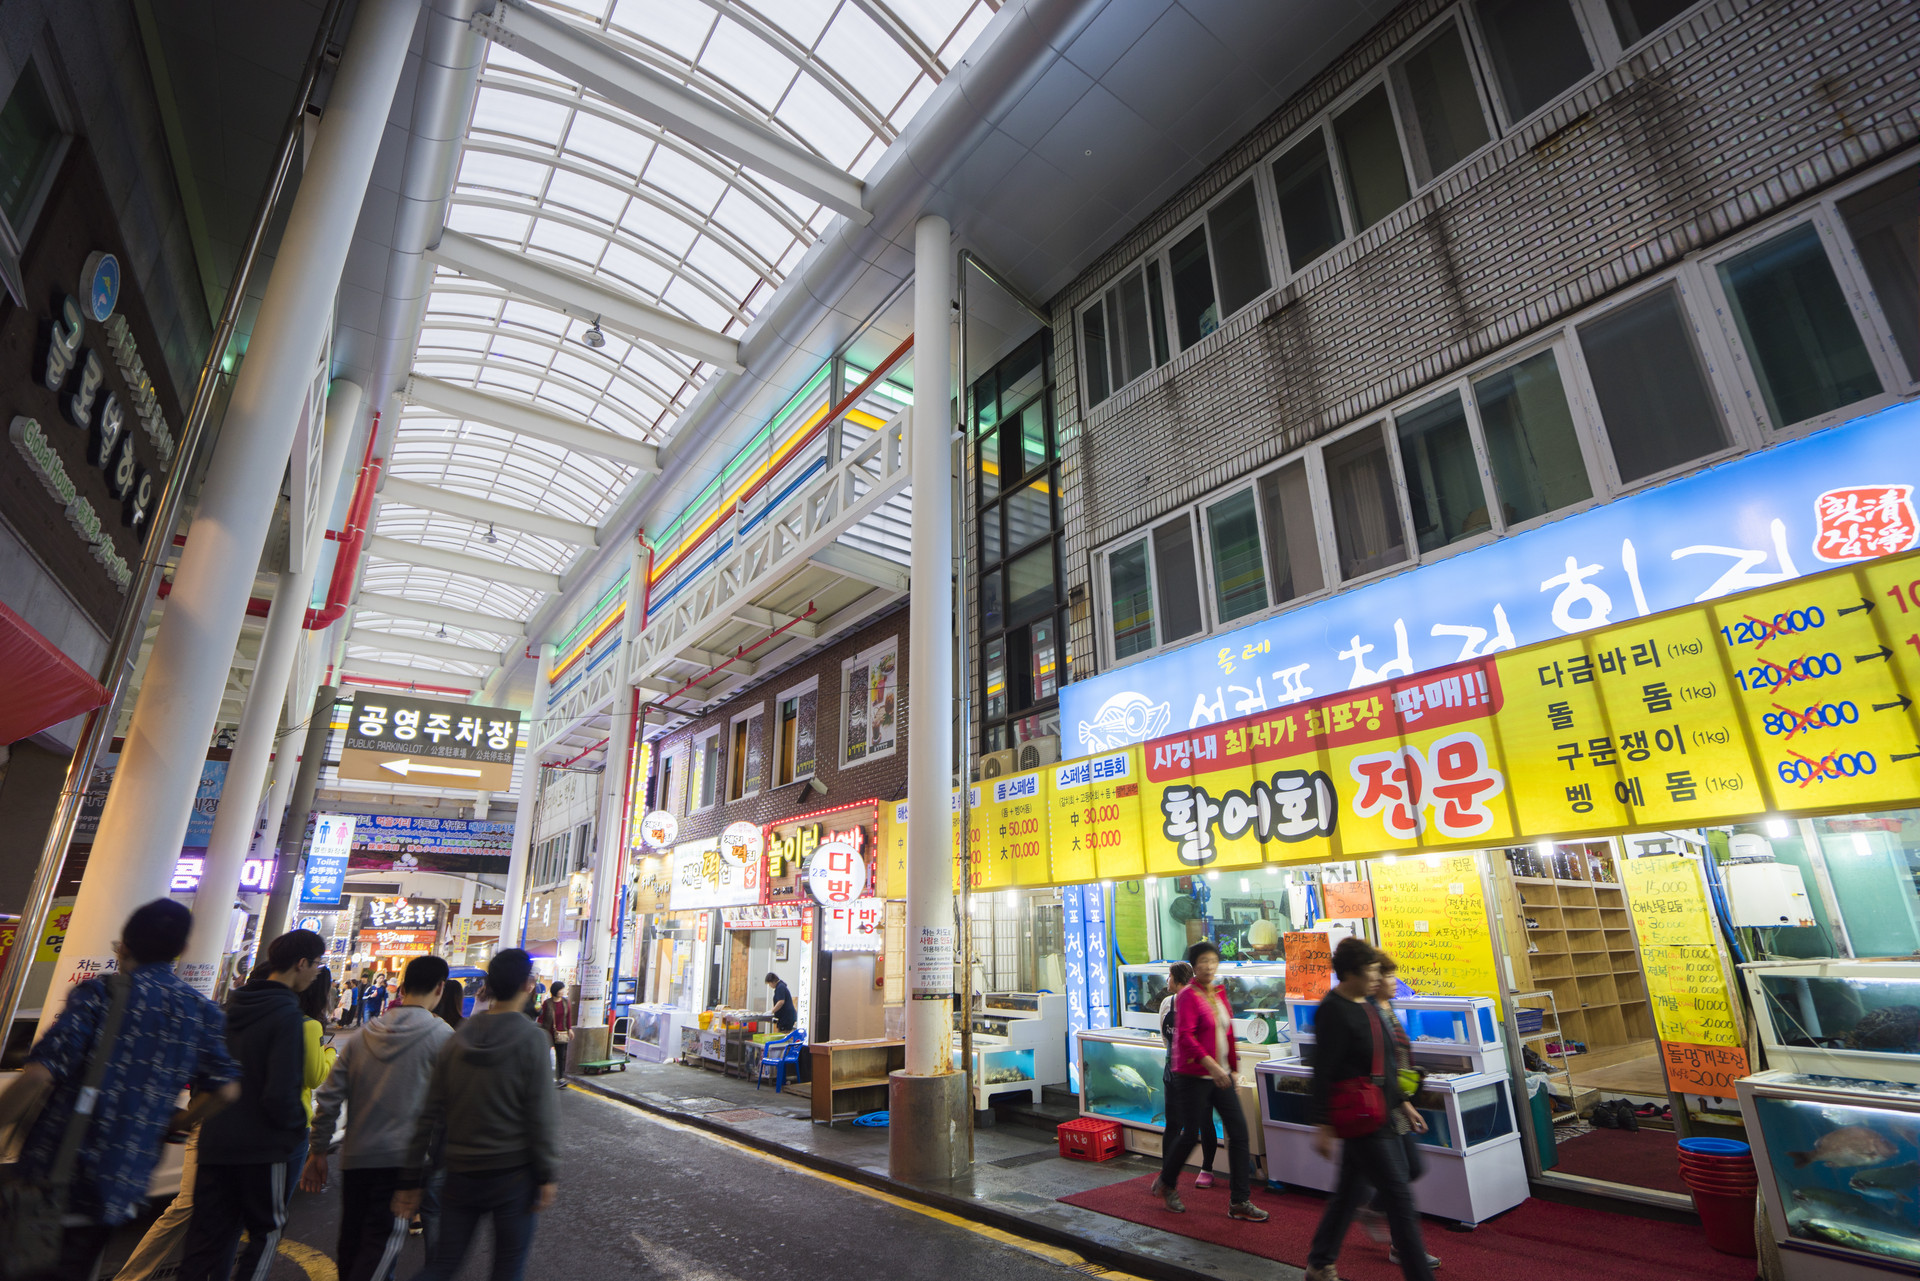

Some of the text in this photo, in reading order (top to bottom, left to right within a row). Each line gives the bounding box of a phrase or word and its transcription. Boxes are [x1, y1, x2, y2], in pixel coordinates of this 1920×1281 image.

[23, 419, 77, 505] Global House
[1720, 605, 1826, 647] 120,000
[1217, 640, 1271, 675] 올레
[1538, 638, 1703, 688] 다금바리 (1kg)
[1734, 652, 1842, 691] 120,000
[1153, 670, 1490, 770] 시장내 최저가 회포장 판매!!
[1547, 681, 1717, 731] 돌 돔 (1kg)
[1762, 700, 1860, 736] 80,000
[357, 705, 514, 750] 공영주차장
[347, 738, 424, 754] PUBLIC PARKING LOT
[1557, 724, 1730, 771] 구문쟁이 (1kg)
[1060, 756, 1126, 786] 스페셜 모듬회
[1777, 750, 1878, 784] 60,000
[998, 777, 1035, 800] 돔 스페셜
[1705, 773, 1744, 794] (1kg)
[1163, 735, 1502, 864] 활어회 전문
[441, 821, 466, 830] 서귀포
[999, 818, 1039, 839] 中 50,000
[1070, 803, 1120, 827] 中 30,000
[768, 823, 819, 877] 놀이터
[1000, 841, 1040, 861] 大 70,000
[1072, 829, 1121, 851] 大 50,000
[316, 858, 340, 866] Toilet
[812, 867, 828, 878] 2층
[828, 852, 853, 902] 다방
[920, 937, 938, 945] 사람은
[922, 928, 934, 936] 차는
[77, 959, 101, 971] 차는
[1667, 1043, 1745, 1069] 돌멍게포장
